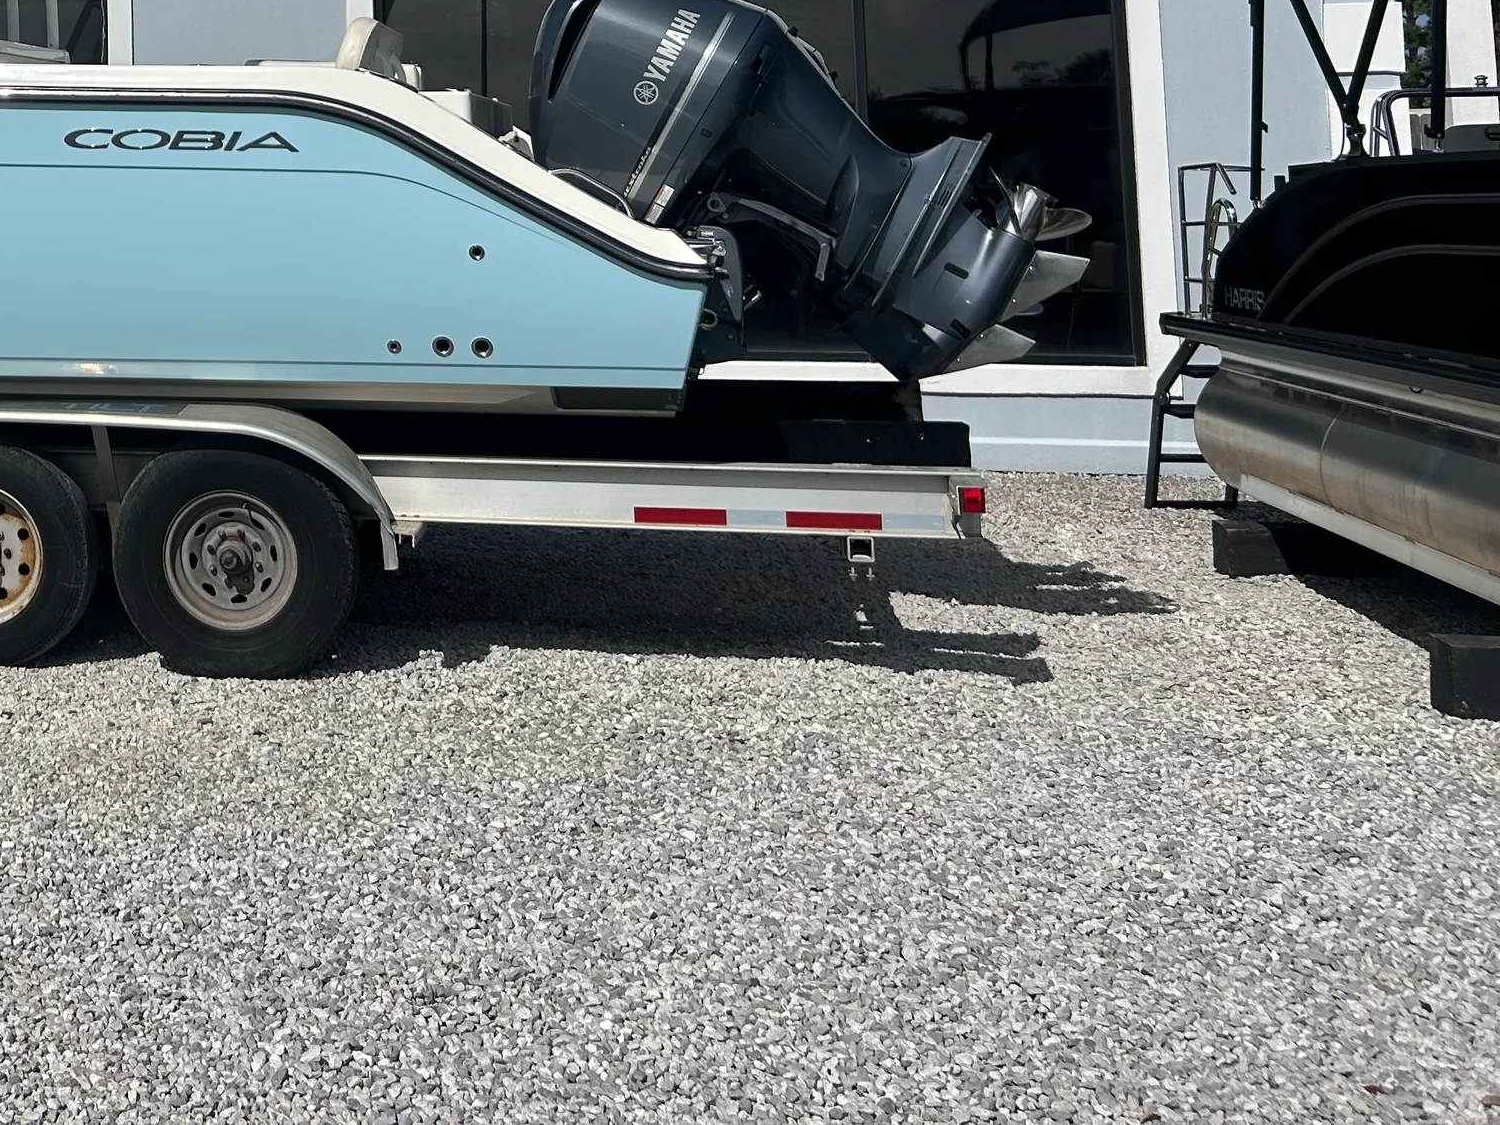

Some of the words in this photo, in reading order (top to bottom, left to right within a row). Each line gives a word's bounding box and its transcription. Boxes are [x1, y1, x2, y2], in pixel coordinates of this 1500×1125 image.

[643, 8, 700, 82] YAMAHA
[64, 128, 299, 153] COBIA
[1224, 285, 1265, 311] HARRIS
